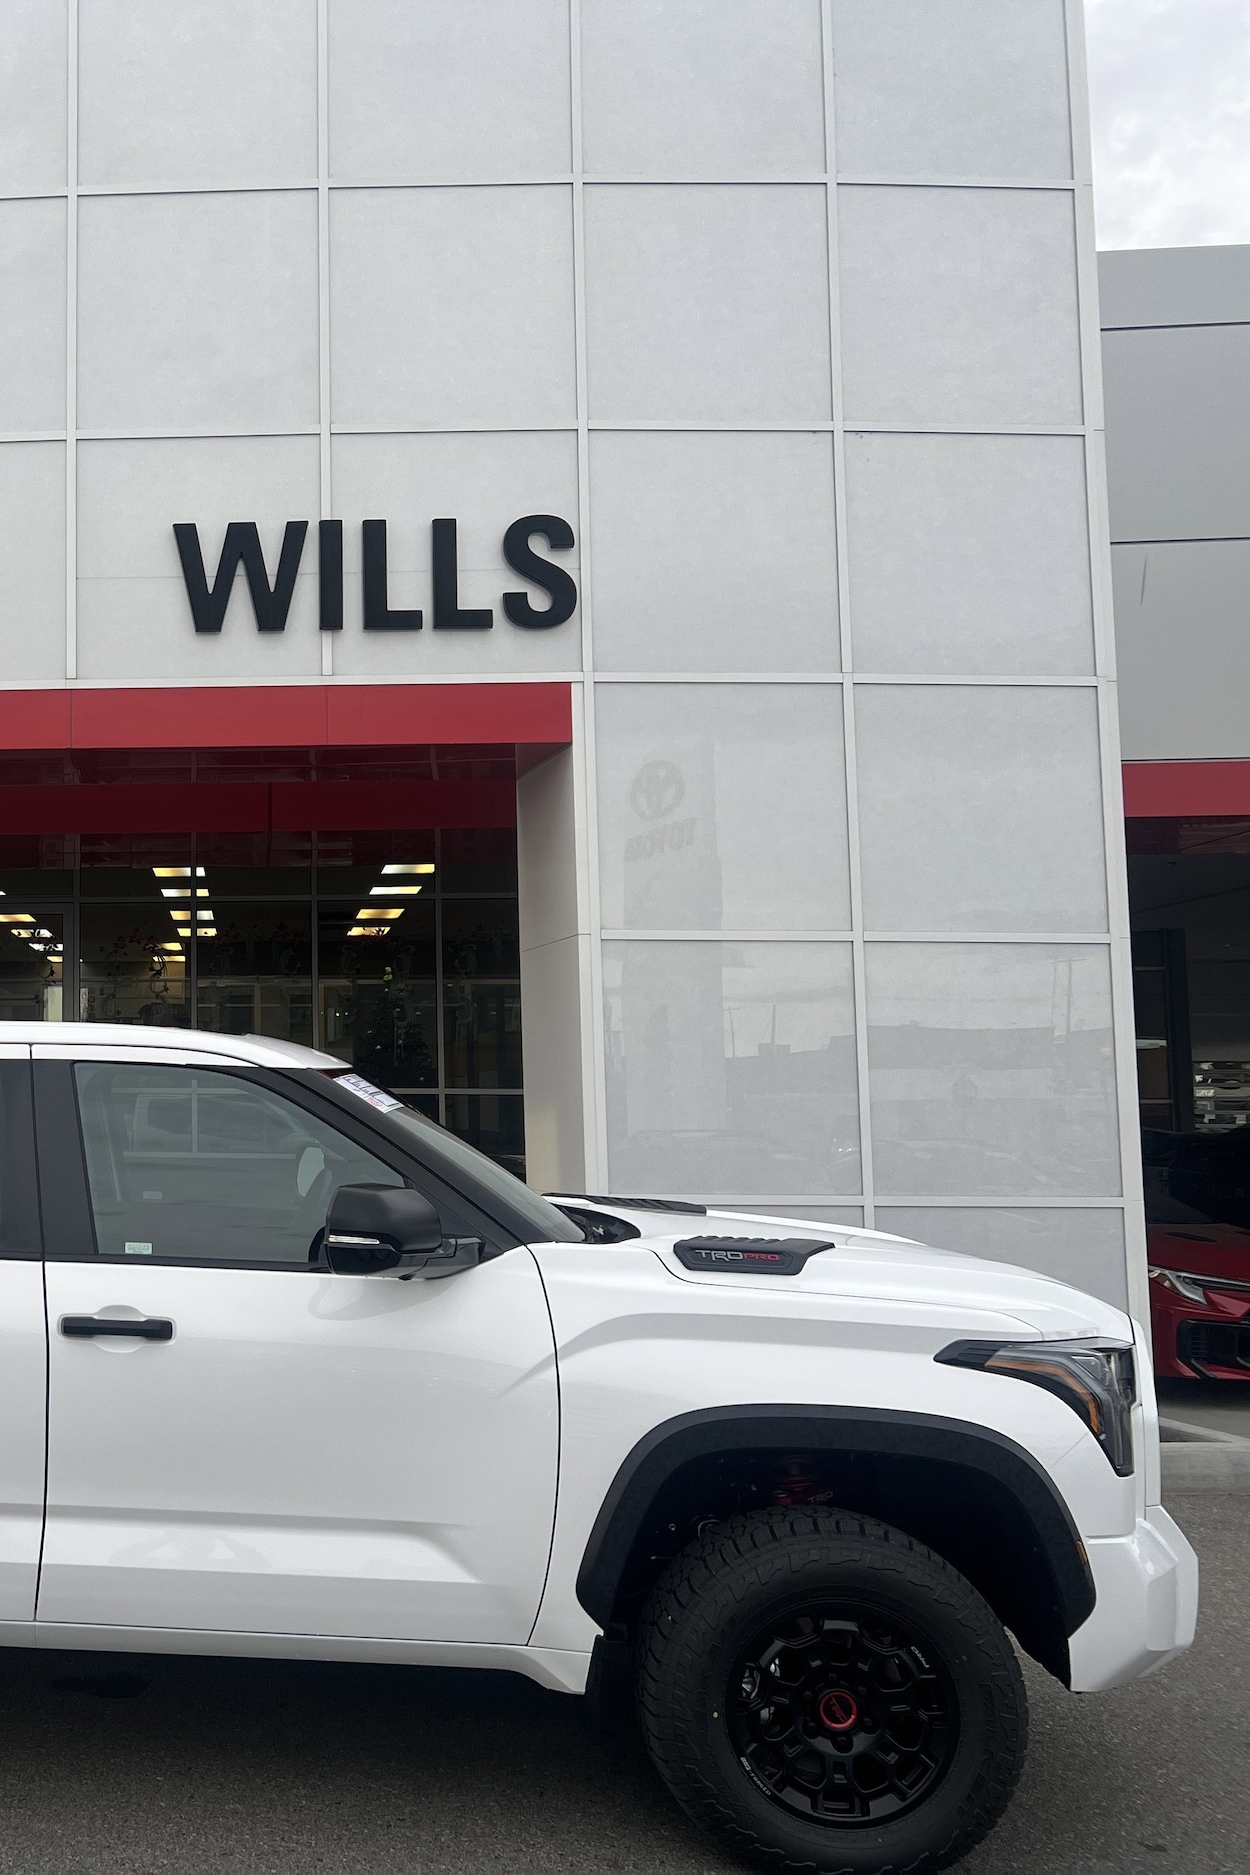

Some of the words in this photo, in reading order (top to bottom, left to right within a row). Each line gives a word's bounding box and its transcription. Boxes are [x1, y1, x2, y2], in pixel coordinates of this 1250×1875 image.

[172, 513, 578, 633] WILLS
[695, 1249, 744, 1262] TRD
[743, 1252, 780, 1262] PRO
